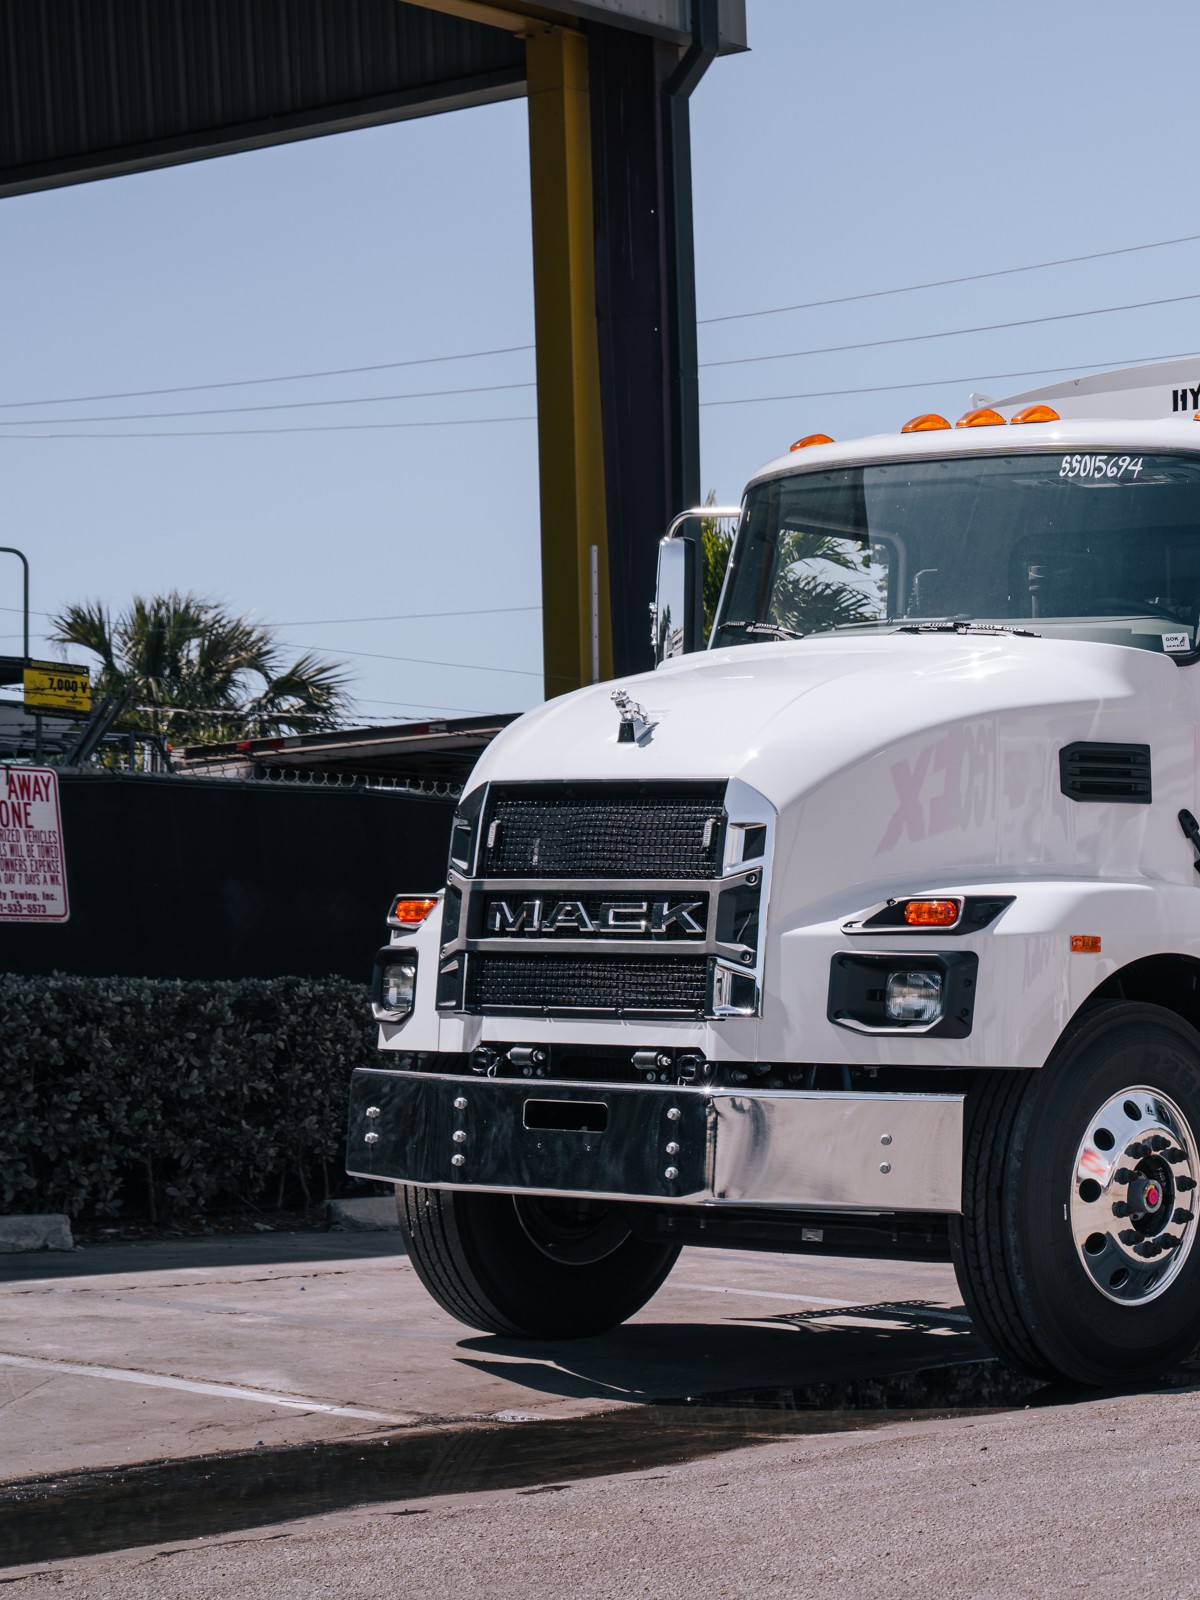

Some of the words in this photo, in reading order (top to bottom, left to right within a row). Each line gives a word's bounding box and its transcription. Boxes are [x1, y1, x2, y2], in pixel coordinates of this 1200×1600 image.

[48, 677, 78, 692] 7,000
[81, 681, 88, 694] V
[8, 773, 52, 802] AWAY
[0, 800, 34, 829] ONE
[24, 830, 58, 844] VEHICLES
[9, 844, 24, 857] WILL
[27, 845, 35, 858] BE
[38, 845, 59, 859] TOWED
[31, 859, 60, 873] EXPENSE
[4, 873, 15, 884] DAY
[18, 873, 22, 884] 7
[25, 874, 40, 885] DAYS
[43, 875, 48, 885] A
[43, 892, 57, 901] Inc.
[488, 900, 706, 932] MACK
